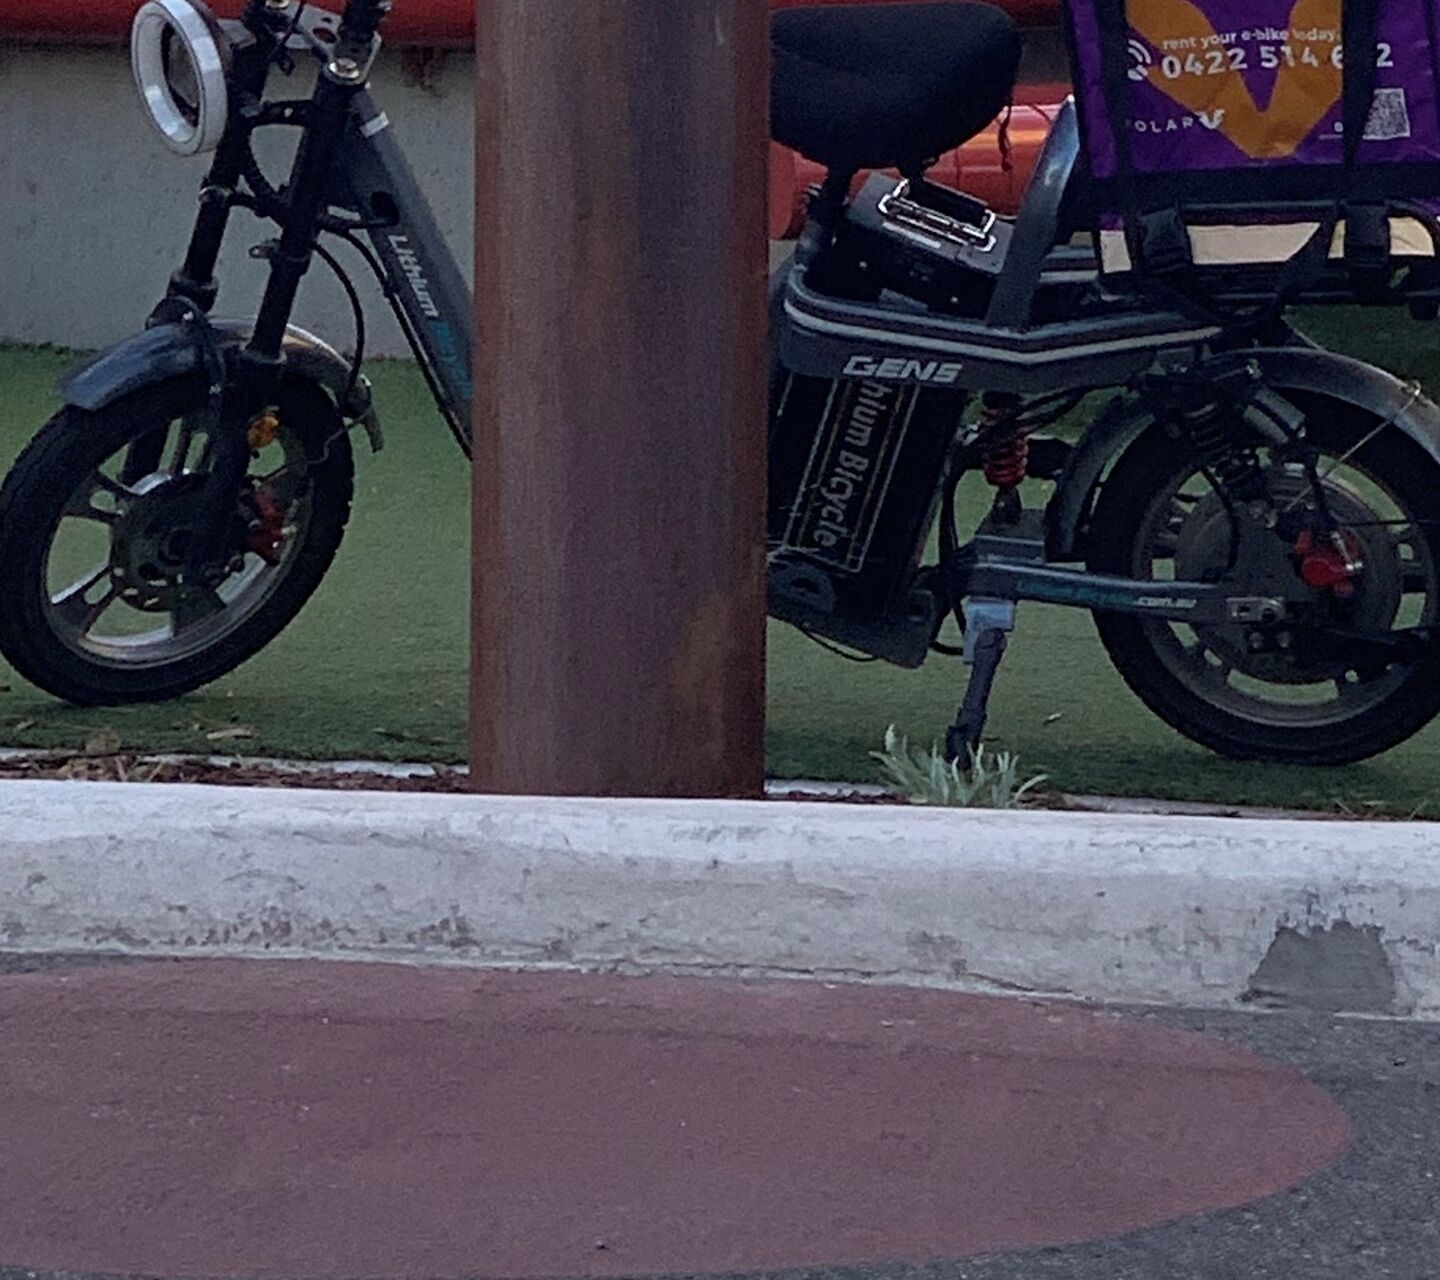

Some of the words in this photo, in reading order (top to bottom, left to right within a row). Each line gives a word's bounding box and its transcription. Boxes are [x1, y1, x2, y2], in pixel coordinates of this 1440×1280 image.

[1199, 31, 1237, 49] your
[1161, 46, 1249, 79] 0422
[1259, 44, 1319, 69] 514
[1330, 42, 1394, 70] 62
[1126, 116, 1194, 134] OLAR
[842, 354, 963, 383] GENS
